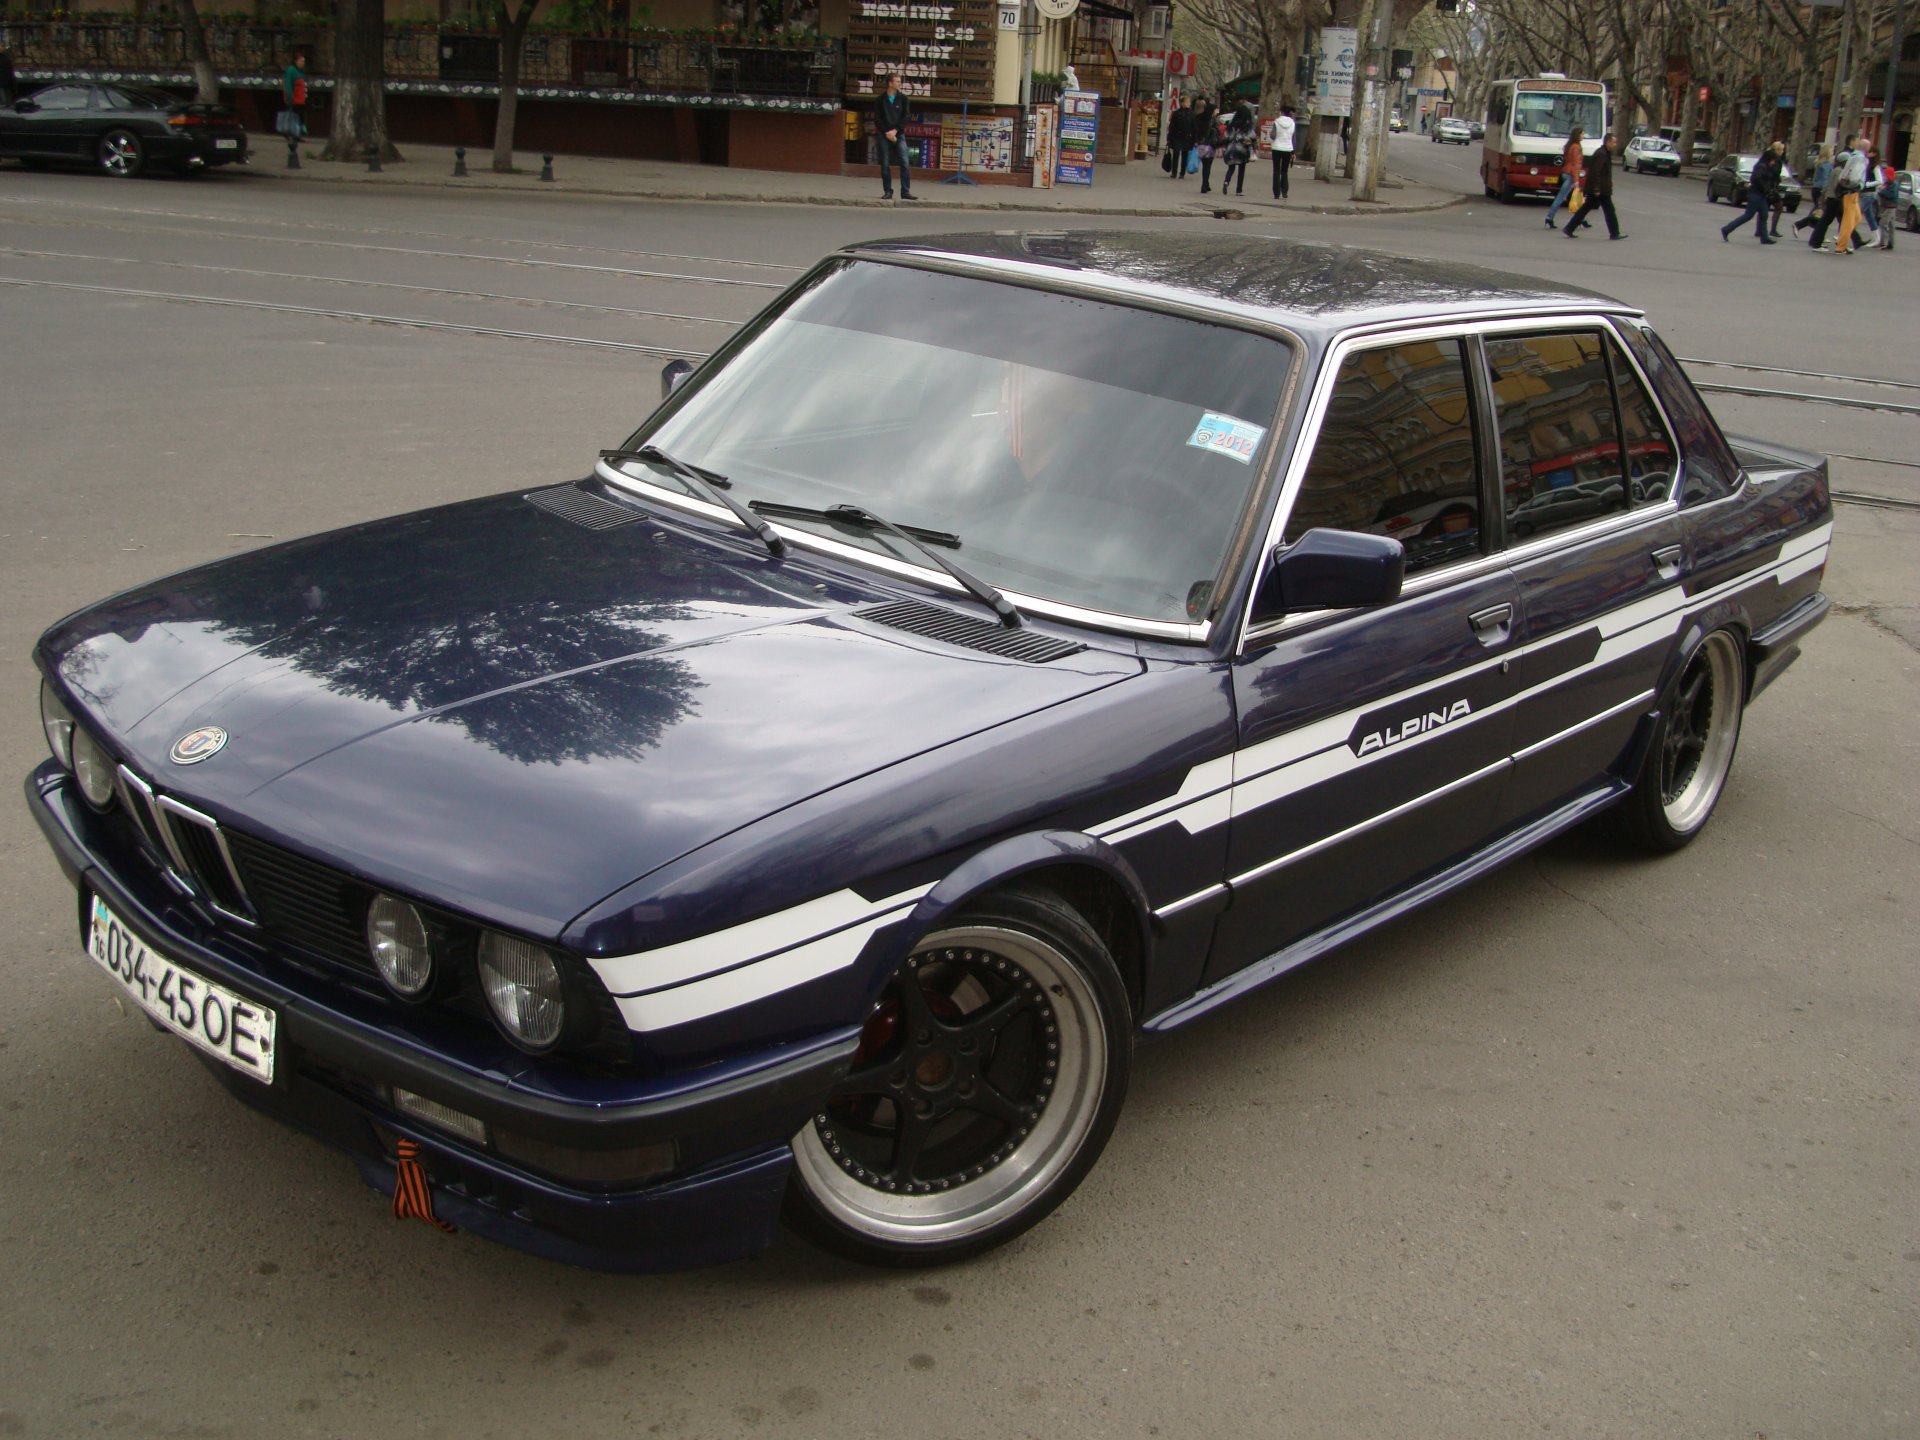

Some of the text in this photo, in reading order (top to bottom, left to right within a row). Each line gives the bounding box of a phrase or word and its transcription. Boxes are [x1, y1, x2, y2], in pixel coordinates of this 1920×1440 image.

[1002, 12, 1016, 24] 70
[1213, 431, 1255, 455] 2012
[1357, 698, 1471, 757] ALPINA
